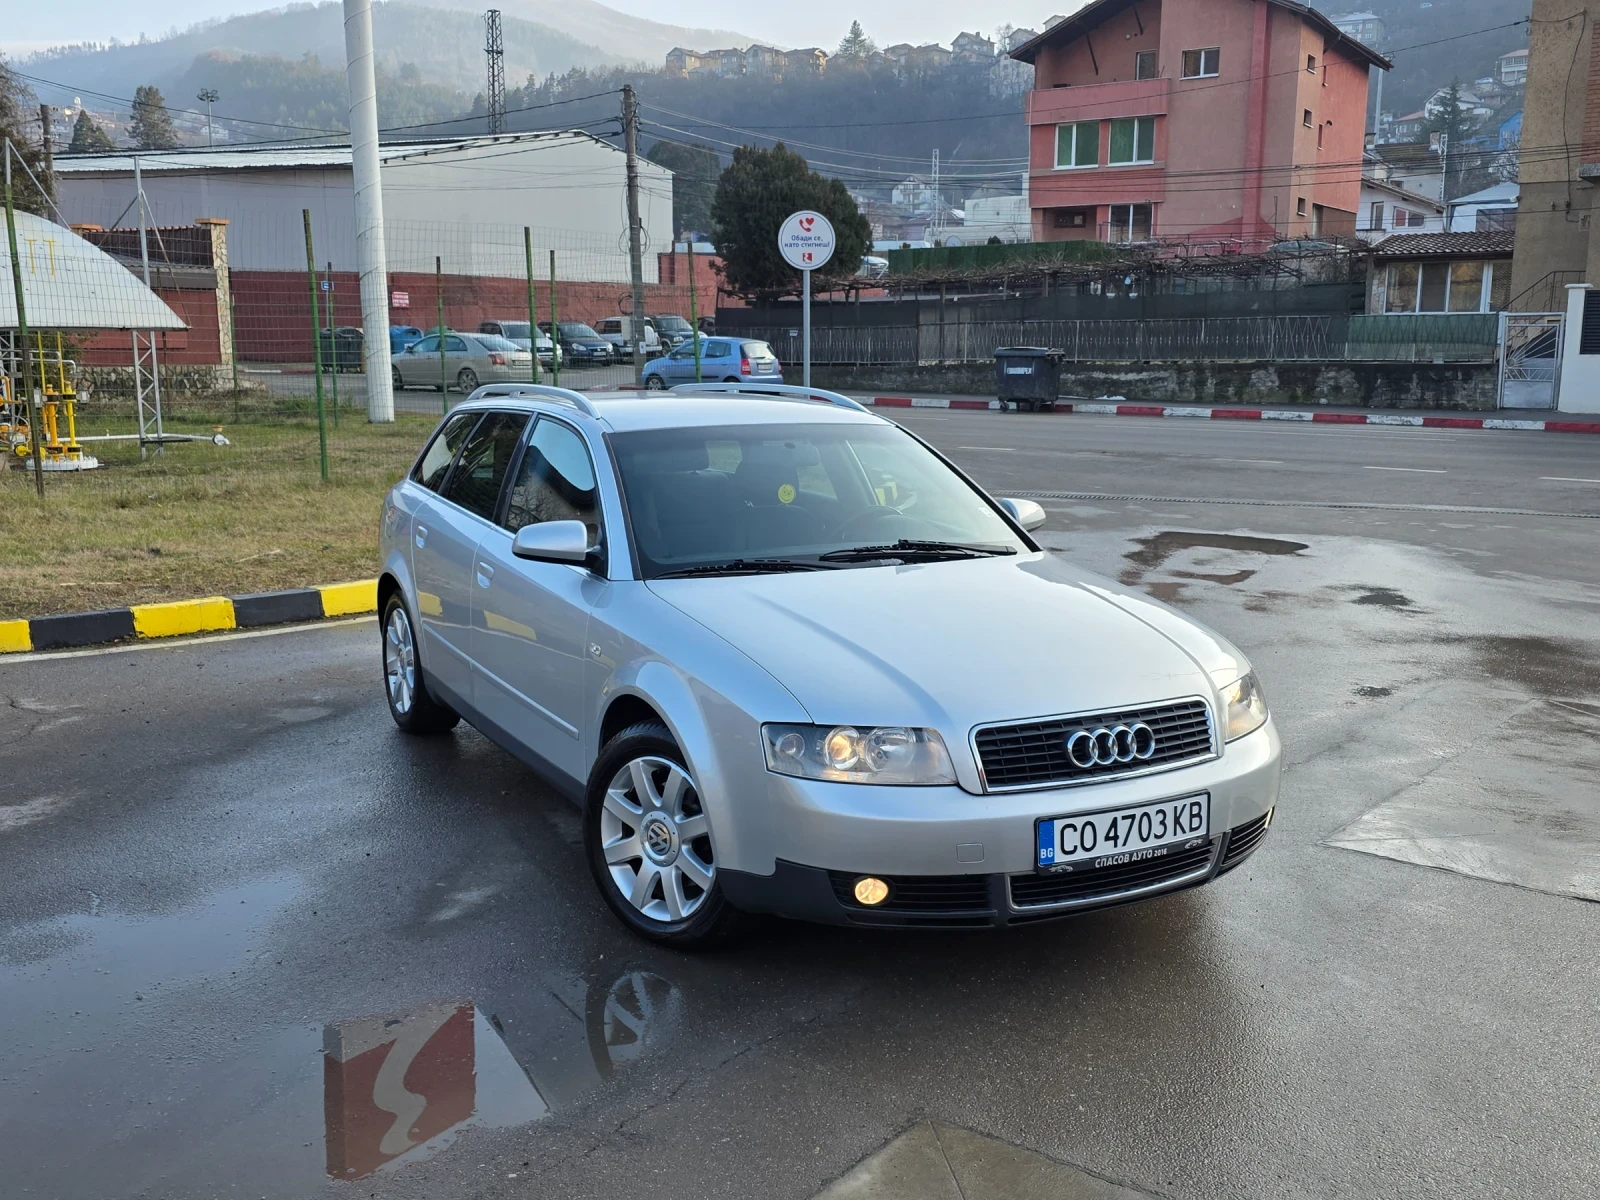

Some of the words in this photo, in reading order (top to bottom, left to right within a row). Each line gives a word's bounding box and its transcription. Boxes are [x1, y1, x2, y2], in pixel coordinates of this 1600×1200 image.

[791, 234, 812, 242] Обади
[1040, 847, 1054, 859] BG
[1094, 853, 1130, 868] СПАСОВ
